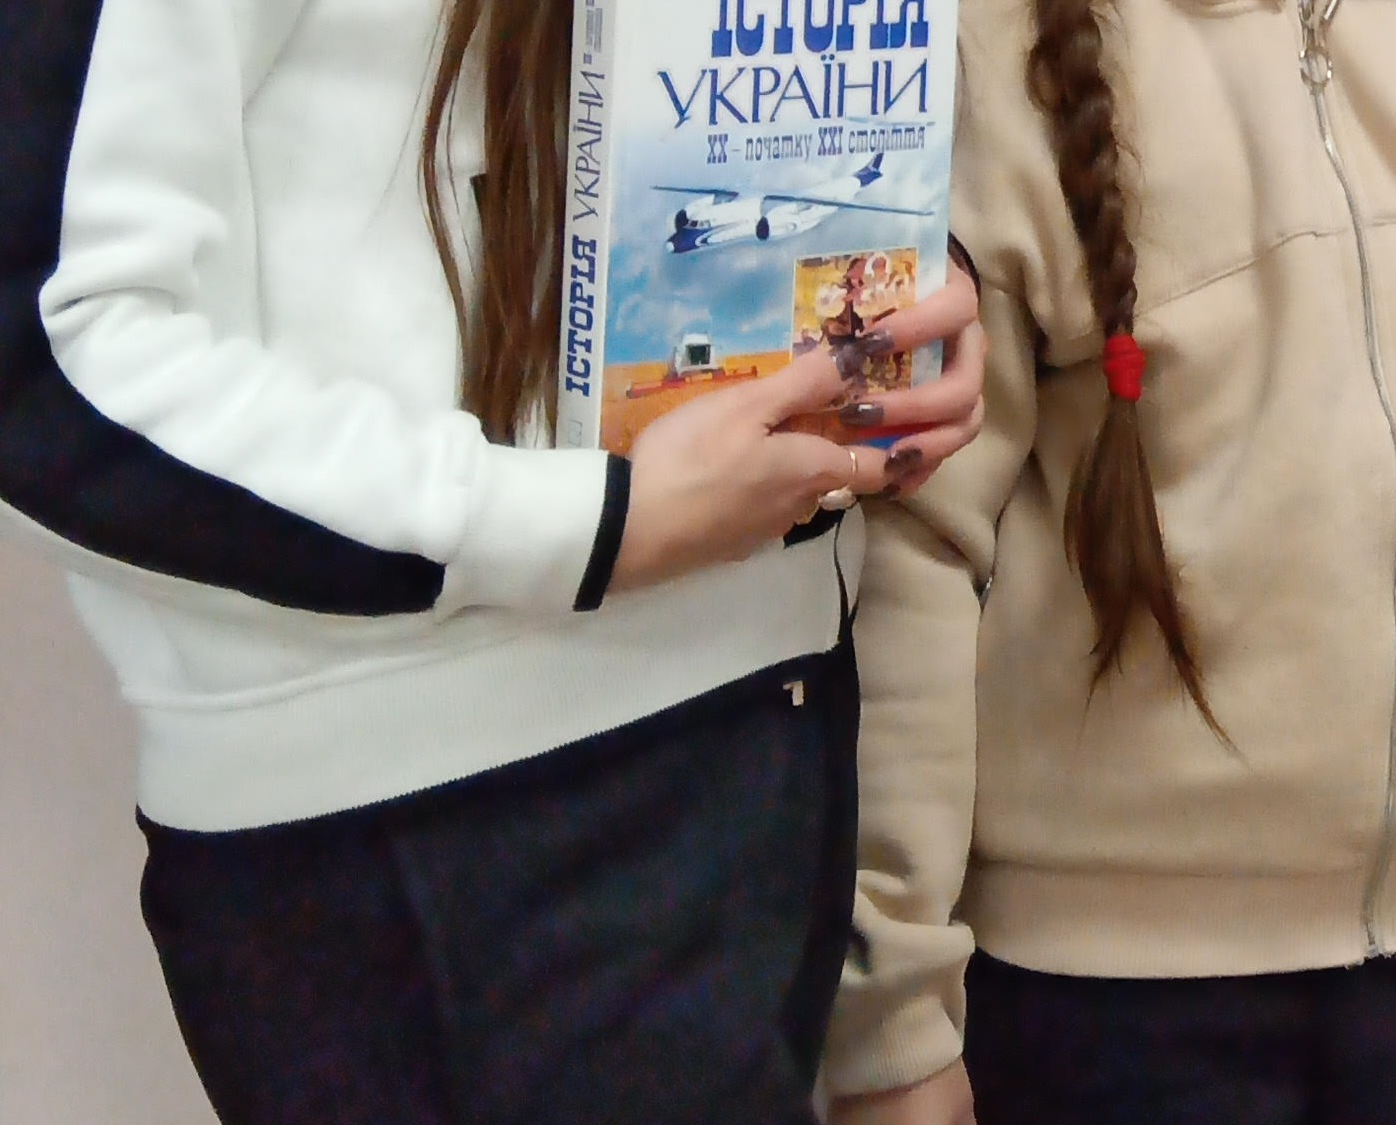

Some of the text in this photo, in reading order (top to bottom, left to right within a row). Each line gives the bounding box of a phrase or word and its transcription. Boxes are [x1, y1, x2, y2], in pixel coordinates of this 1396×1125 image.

[657, 54, 929, 129] УКРАЇНИ
[571, 70, 606, 222] УКРАЇНИ
[744, 132, 813, 163] початку
